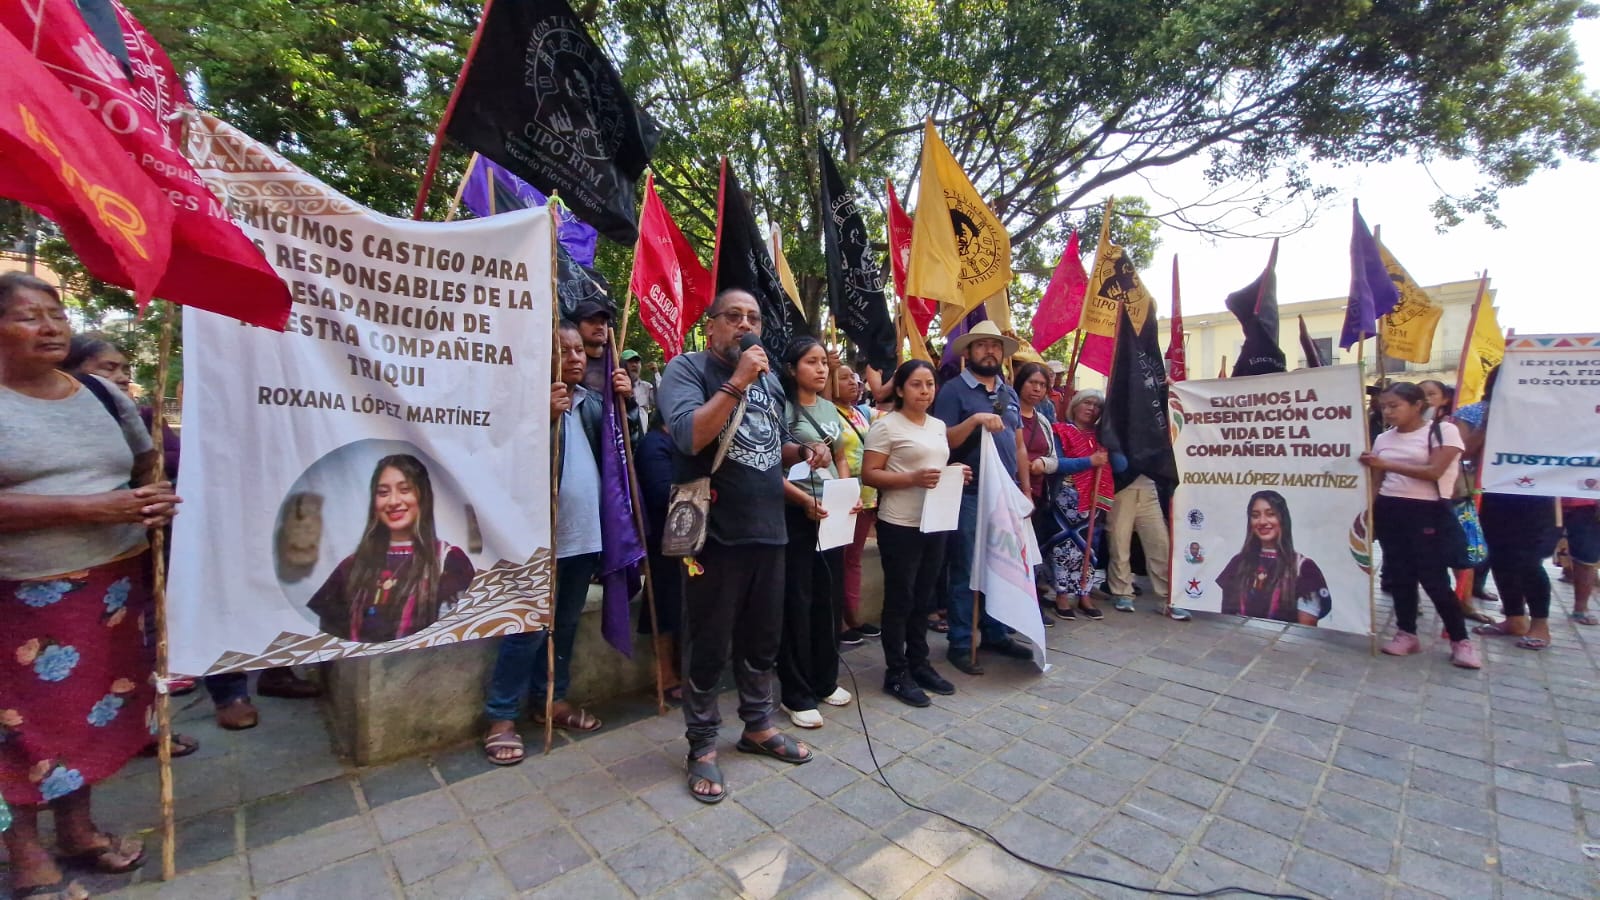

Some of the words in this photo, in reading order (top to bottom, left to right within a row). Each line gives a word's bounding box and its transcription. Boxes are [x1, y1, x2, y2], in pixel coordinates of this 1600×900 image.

[504, 141, 540, 170] Ricardo
[540, 162, 572, 190] Flores
[524, 122, 604, 188] CIPO-RFM
[362, 234, 465, 273] CASTIGO
[471, 255, 528, 282] PARA
[276, 243, 466, 303] RESPONSABLES
[473, 284, 500, 308] DE
[507, 288, 533, 310] LA
[283, 279, 455, 332] ESAPARICIÓN
[463, 312, 490, 334] DE
[368, 329, 514, 365] COMPAÑERA
[346, 353, 425, 387] TRIQUI
[258, 386, 345, 411] ROXANA
[351, 392, 400, 419] LÓPEZ
[406, 404, 490, 427] MARTÍNEZ
[1184, 407, 1309, 425] PRESENTACIÓN
[1312, 405, 1352, 420] CON
[1210, 391, 1291, 408] EXIGIMOS
[1294, 388, 1318, 403] LA
[1186, 441, 1288, 457] COMPAÑERA
[1290, 443, 1351, 457] TRIQUI
[1220, 426, 1260, 441] VIDA
[1263, 426, 1284, 440] DE
[1288, 425, 1311, 439] LA
[1183, 471, 1235, 485] ROXANA
[1235, 470, 1280, 486] LÓPEZ
[1282, 471, 1359, 489] MARTÍNEZ
